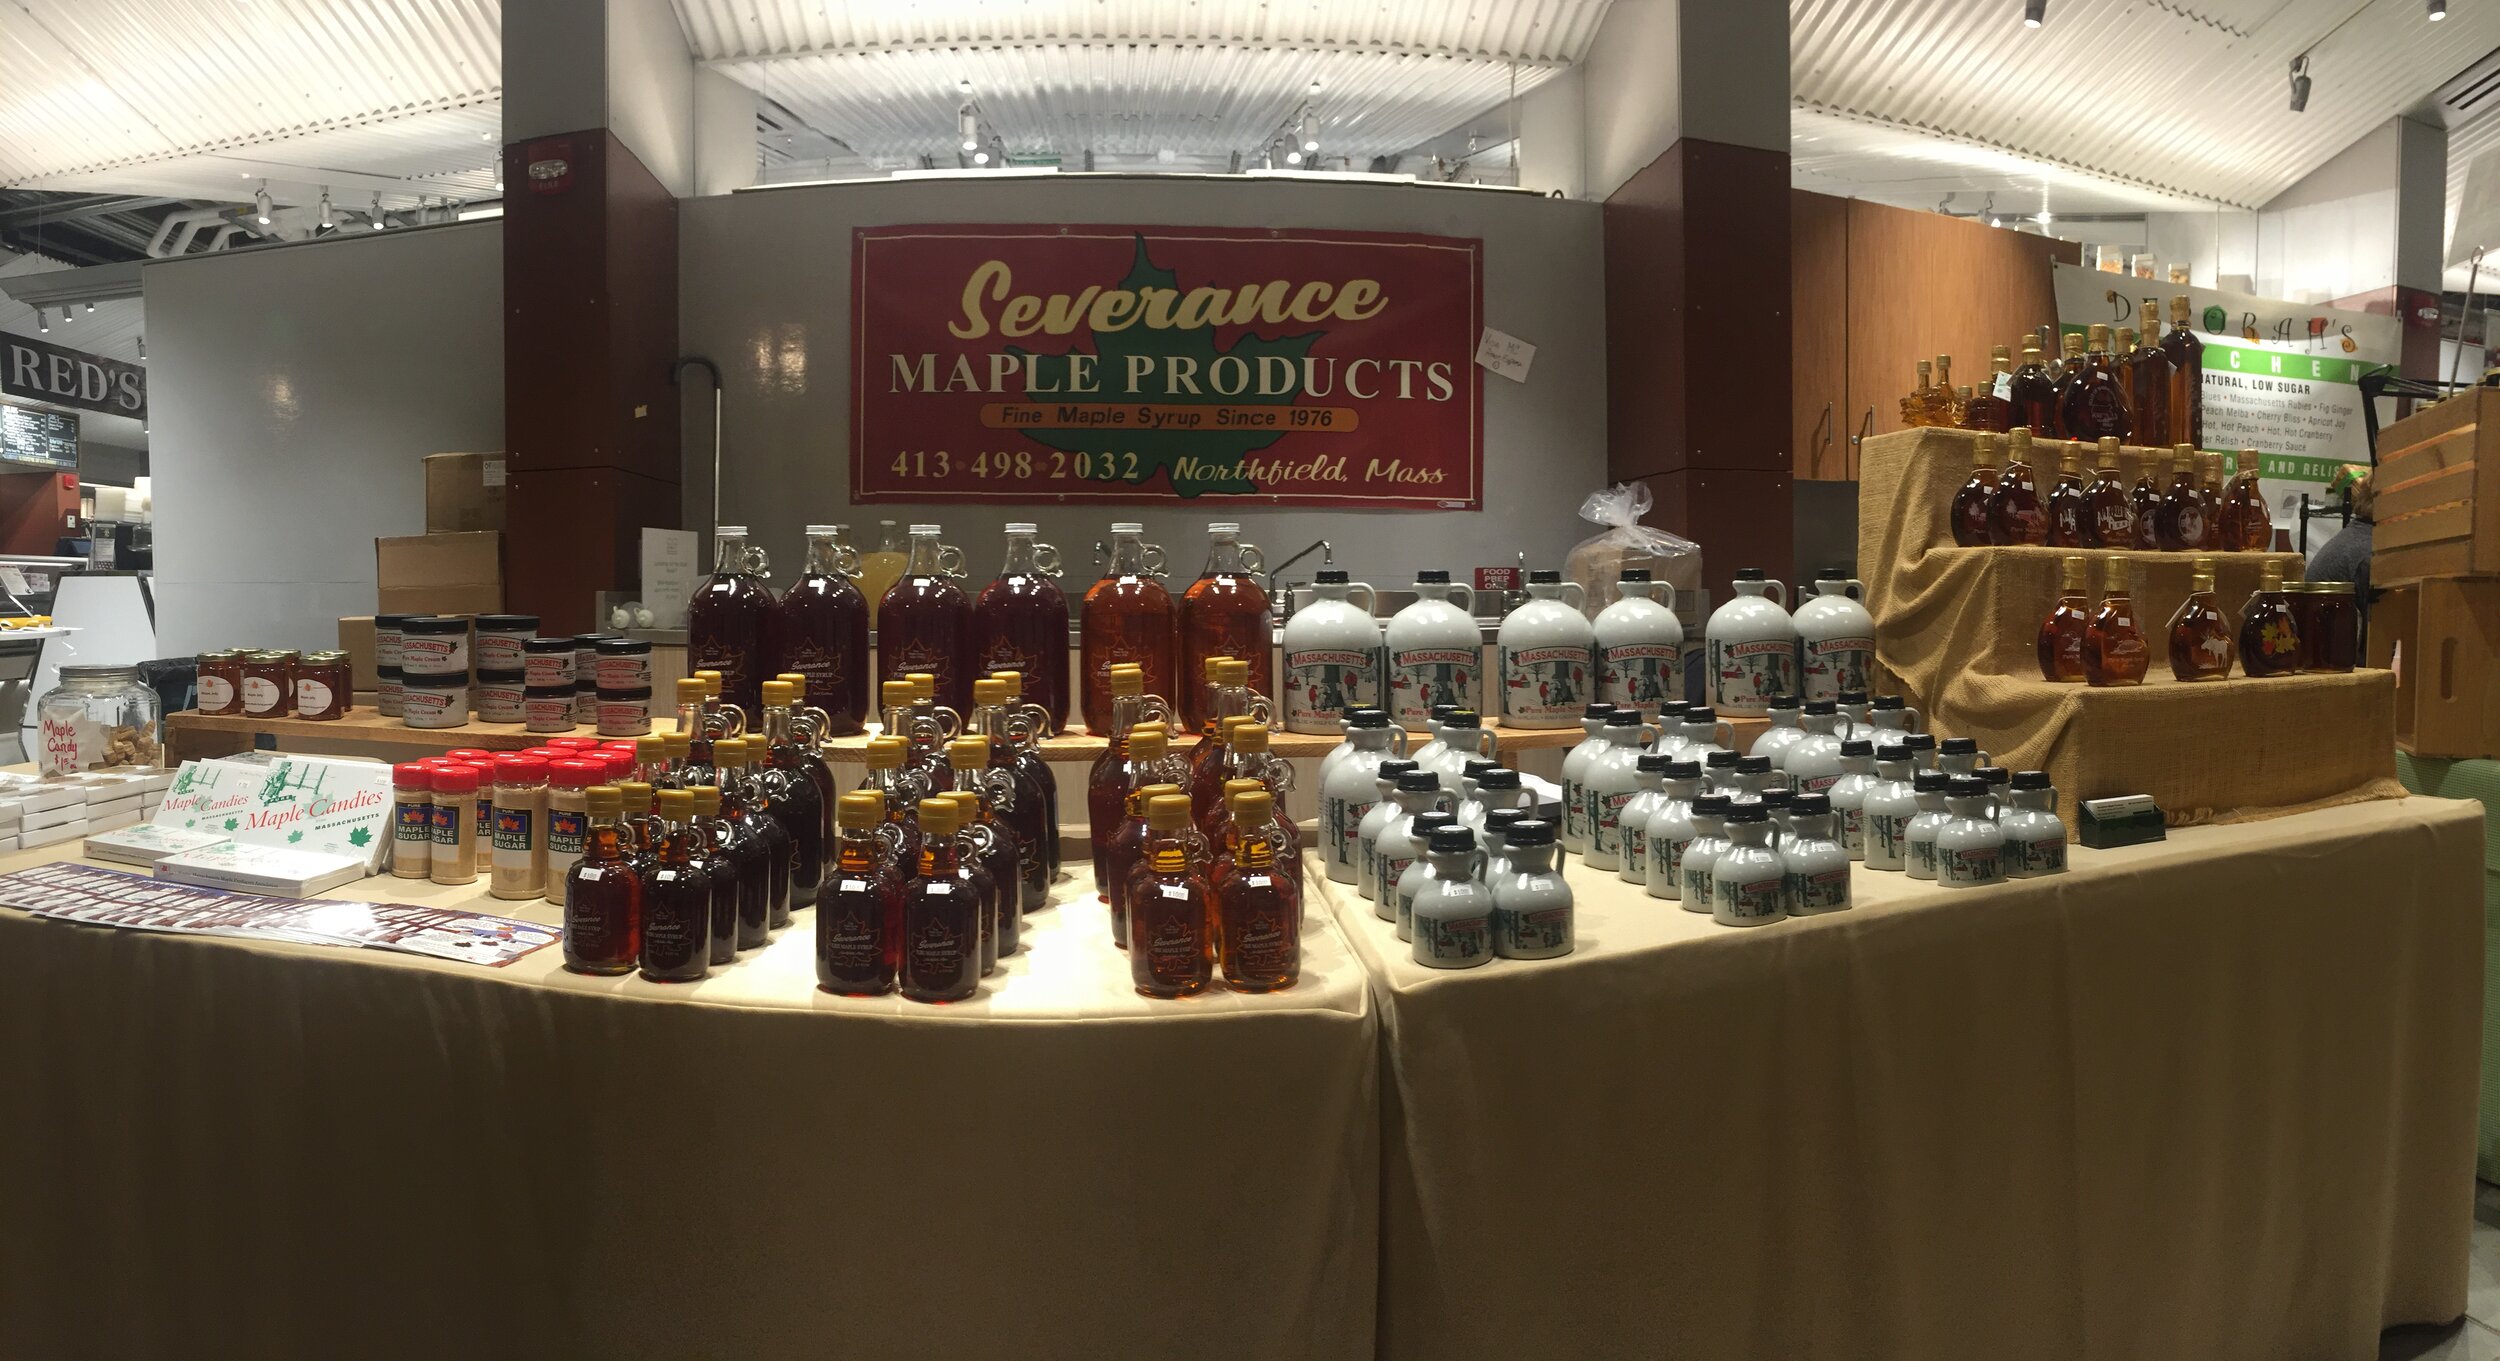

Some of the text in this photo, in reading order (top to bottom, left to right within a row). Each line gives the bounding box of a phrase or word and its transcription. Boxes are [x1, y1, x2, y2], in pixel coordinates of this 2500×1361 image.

[947, 260, 1389, 339] Severance
[10, 344, 142, 410] RED'S
[889, 353, 1454, 402] MAPLE PRODUCTS
[2252, 379, 2274, 391] LOW
[2277, 382, 2311, 395] SUGAR
[1001, 406, 1333, 429] Fine Maple Syrup Since 1976
[2226, 406, 2249, 419] Melba
[2256, 410, 2281, 424] Cherry
[2283, 413, 2300, 423] Bliss
[2307, 416, 2333, 428] Apricot
[2221, 422, 2235, 431] Hot
[2237, 422, 2259, 433] Peach
[2284, 428, 2298, 437] Hot
[2299, 429, 2333, 442] Cranberry
[2215, 434, 2239, 445] Relish
[2246, 437, 2283, 451] Cranberry
[2285, 441, 2307, 451] Sauce
[1172, 454, 1348, 486] Northfield,
[1365, 458, 1449, 483] Mass
[2268, 460, 2295, 474] AND
[791, 660, 830, 671] Severance
[1293, 652, 1365, 666] MASSACHUSETTS
[1402, 652, 1473, 665] MASSACHUSETTS
[897, 662, 938, 672] Severance
[1544, 706, 1566, 714] Maple
[44, 719, 76, 741] Maple
[48, 737, 77, 760] Candy
[162, 794, 249, 812] Maple Candies
[244, 790, 383, 831] Maple Candies
[314, 812, 380, 831] MASSACHUSETTS
[398, 825, 430, 833] MAPLE
[398, 832, 430, 840] SUGAR
[494, 832, 526, 841] MAPLE
[549, 834, 582, 845] MAPLE
[494, 839, 526, 850] SUGAR
[549, 842, 582, 852] SUGAR
